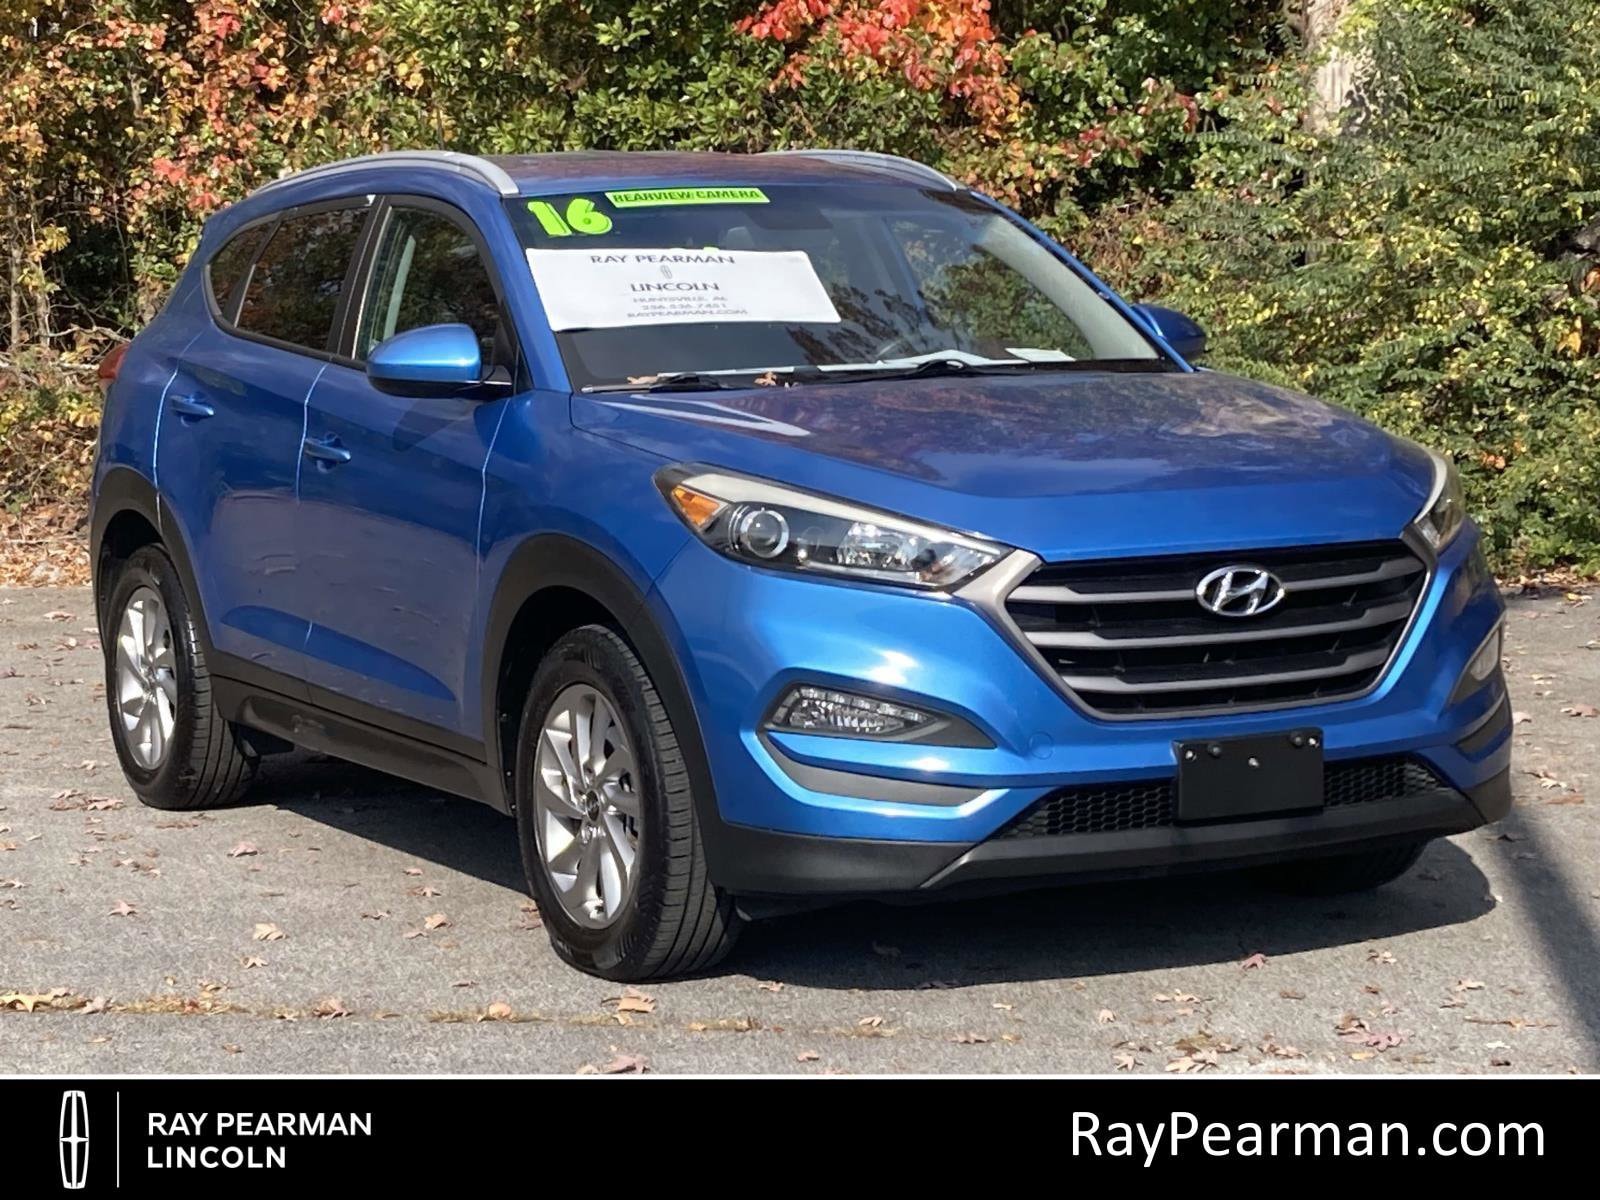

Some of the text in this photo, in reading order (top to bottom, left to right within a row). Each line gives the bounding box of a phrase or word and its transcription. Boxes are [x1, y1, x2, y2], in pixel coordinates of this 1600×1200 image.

[613, 190, 761, 202] REARVIEW CAMERA
[527, 198, 613, 237] 16
[590, 255, 736, 264] RAY PEARMAN
[630, 282, 720, 293] LINCOLN
